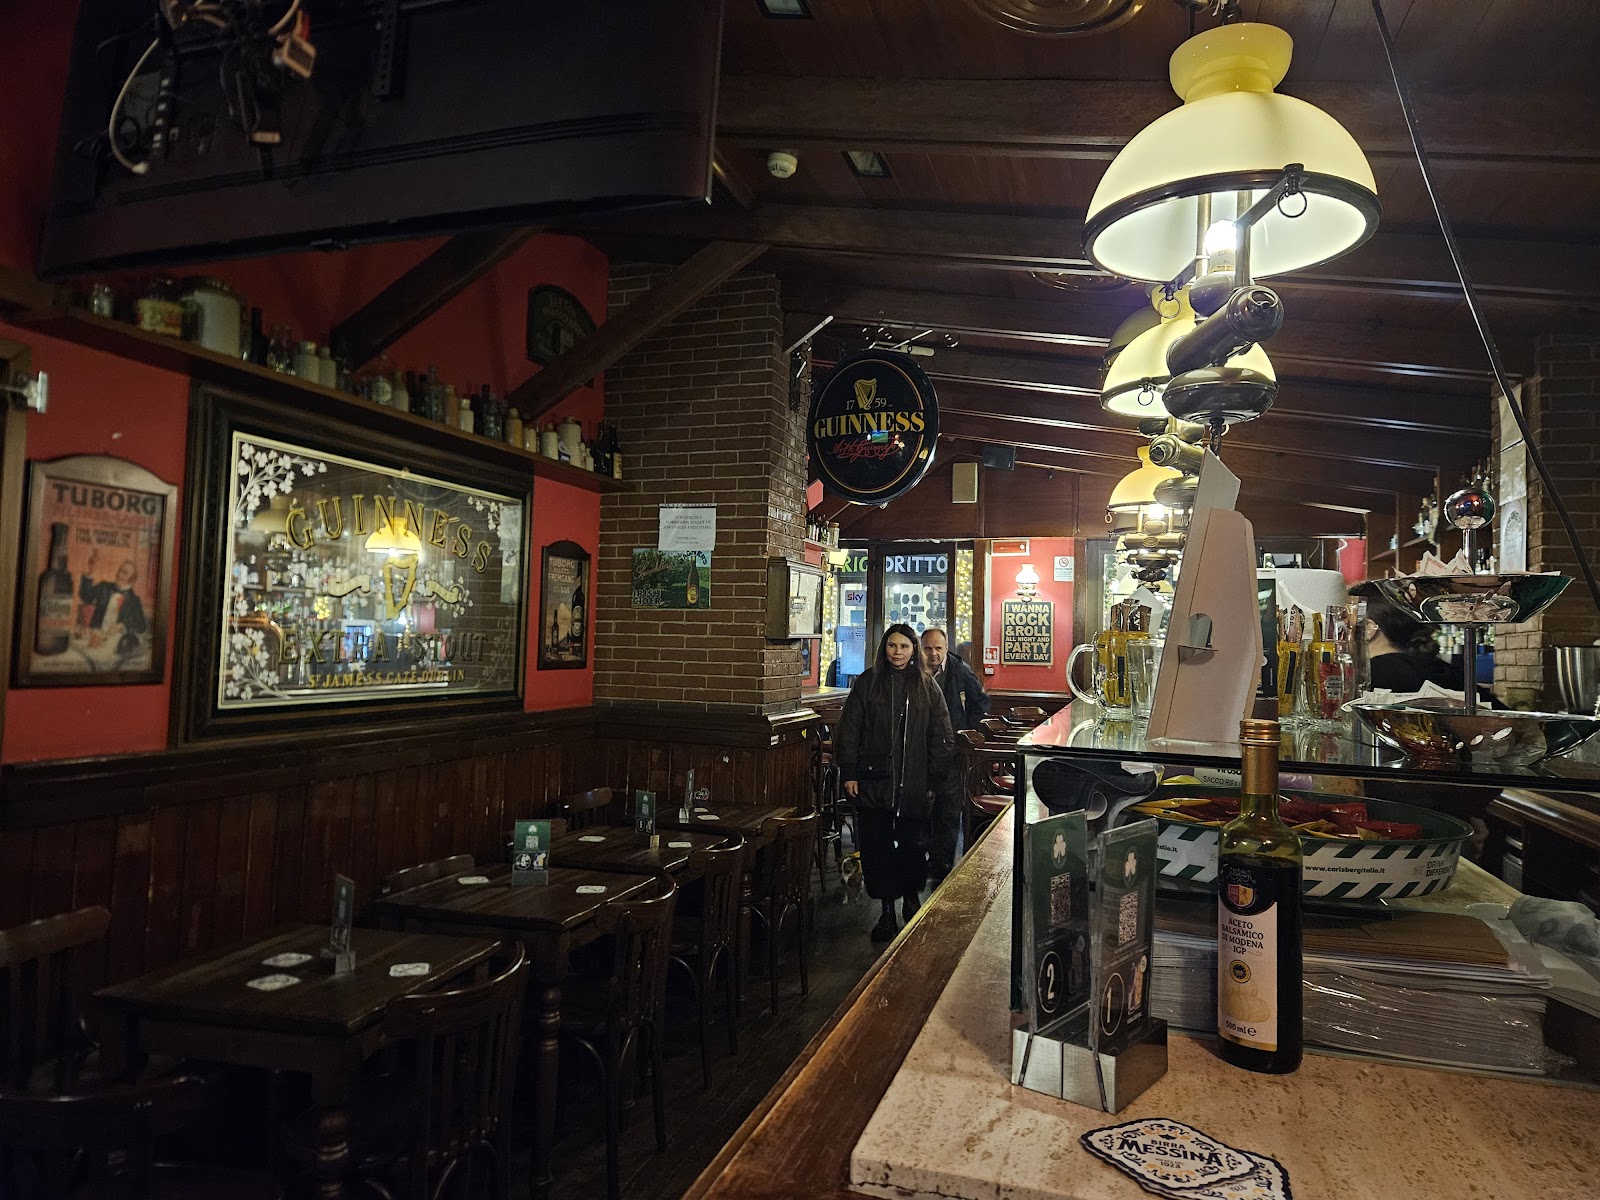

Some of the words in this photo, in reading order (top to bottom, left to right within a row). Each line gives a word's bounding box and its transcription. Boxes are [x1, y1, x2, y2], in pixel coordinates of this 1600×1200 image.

[846, 400, 855, 410] 17
[874, 398, 887, 408] 59
[814, 411, 925, 439] GUINNESS
[52, 483, 156, 516] TUBORG
[285, 494, 493, 573] GUINNESS
[549, 557, 575, 569] TUBORG
[886, 556, 948, 573] DRITTO
[633, 588, 662, 598] IRISH
[847, 590, 864, 603] sky
[633, 597, 662, 605] CIDER
[1012, 604, 1050, 613] WANNA
[1005, 613, 1050, 625] ROCK
[279, 629, 390, 664] EXTRA
[414, 632, 489, 662] STOUT
[1005, 642, 1050, 653] PARTY
[1203, 775, 1225, 785] SACCO
[1305, 865, 1386, 875] www.carlsbergitalia.it
[1427, 860, 1446, 869] DRINK
[1228, 918, 1253, 929] ACETO
[1222, 924, 1264, 940] BALSAMICO
[1222, 932, 1228, 941] DI
[1229, 936, 1264, 949] MODENA
[1233, 946, 1247, 955] IGP
[1047, 963, 1055, 1000] 2
[1107, 987, 1112, 1023] 1
[1226, 1020, 1236, 1031] 500
[1237, 1026, 1246, 1034] ml
[1151, 1139, 1186, 1150] BIRRA
[1118, 1138, 1224, 1167] MESSINA
